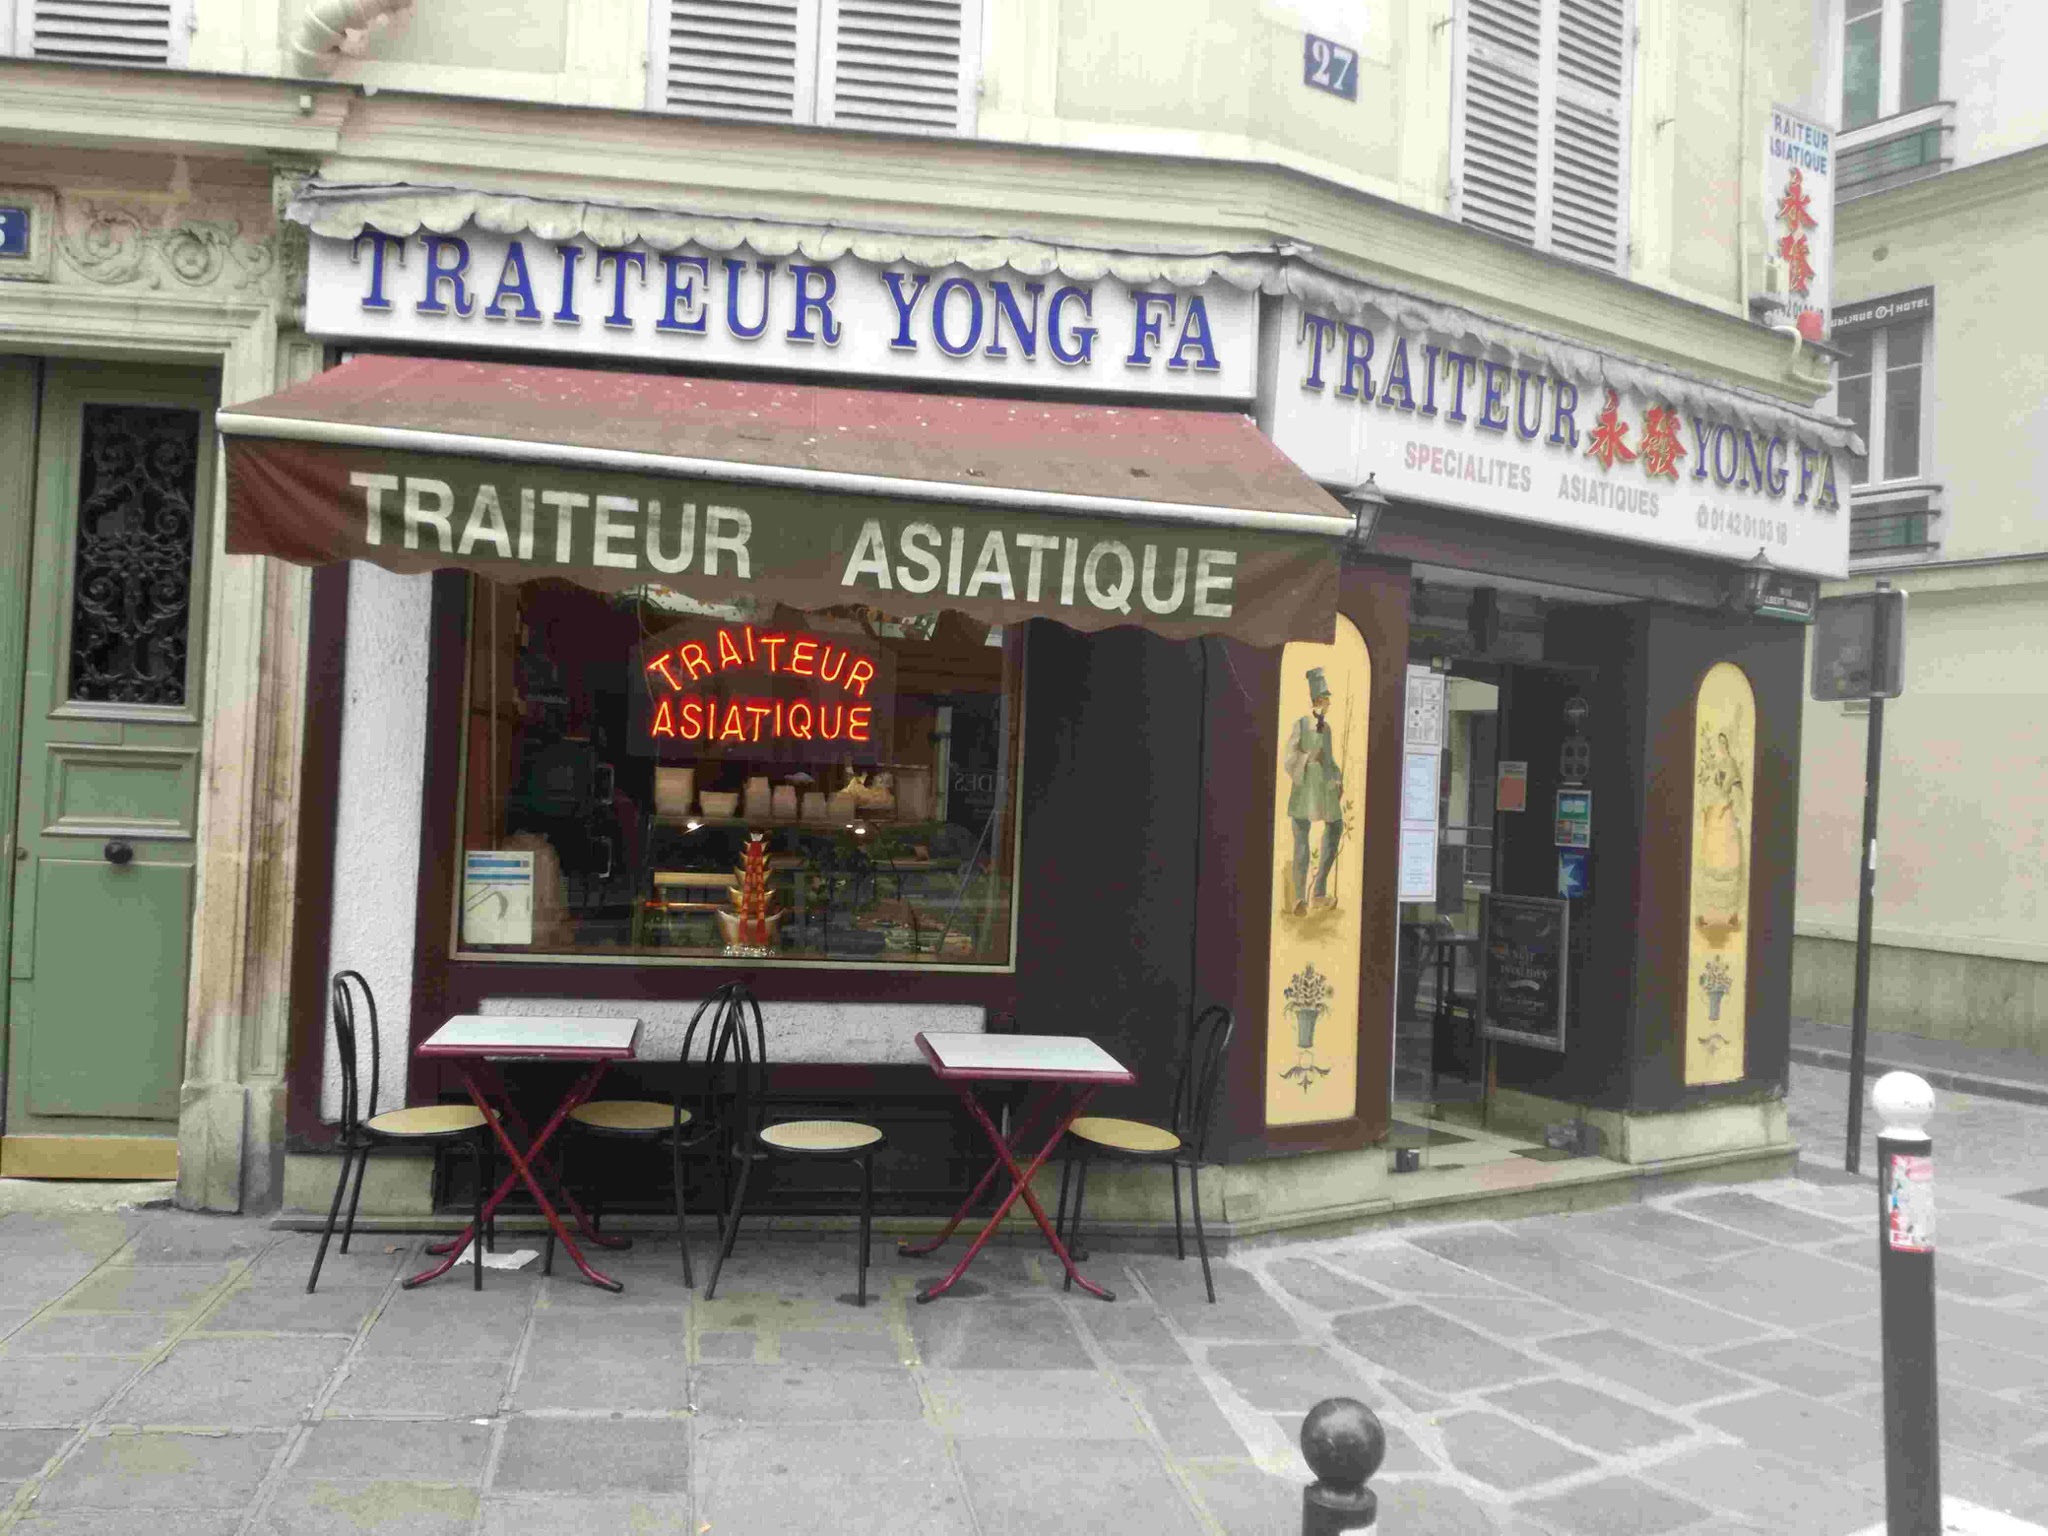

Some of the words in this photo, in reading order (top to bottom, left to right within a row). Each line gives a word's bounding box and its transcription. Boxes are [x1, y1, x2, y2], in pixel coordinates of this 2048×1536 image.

[1312, 40, 1352, 90] 27
[1771, 113, 1828, 151] RAITEUR
[350, 230, 842, 347] TRAITEUR
[880, 271, 1099, 366] YONG
[1125, 290, 1221, 370] FA
[1896, 297, 1930, 313] HOTEL
[1298, 311, 1579, 449] TRAITEUR
[1691, 417, 1789, 497] YONG
[1794, 446, 1840, 512] FA
[1403, 440, 1532, 493] SPECIALITES
[1557, 473, 1660, 518] ASIATIQUES
[350, 472, 752, 579] TRAITEUR
[841, 517, 1238, 617] ASIATIQUE
[648, 625, 874, 697] TRAITEUR
[652, 701, 872, 742] ASIATIQUE
